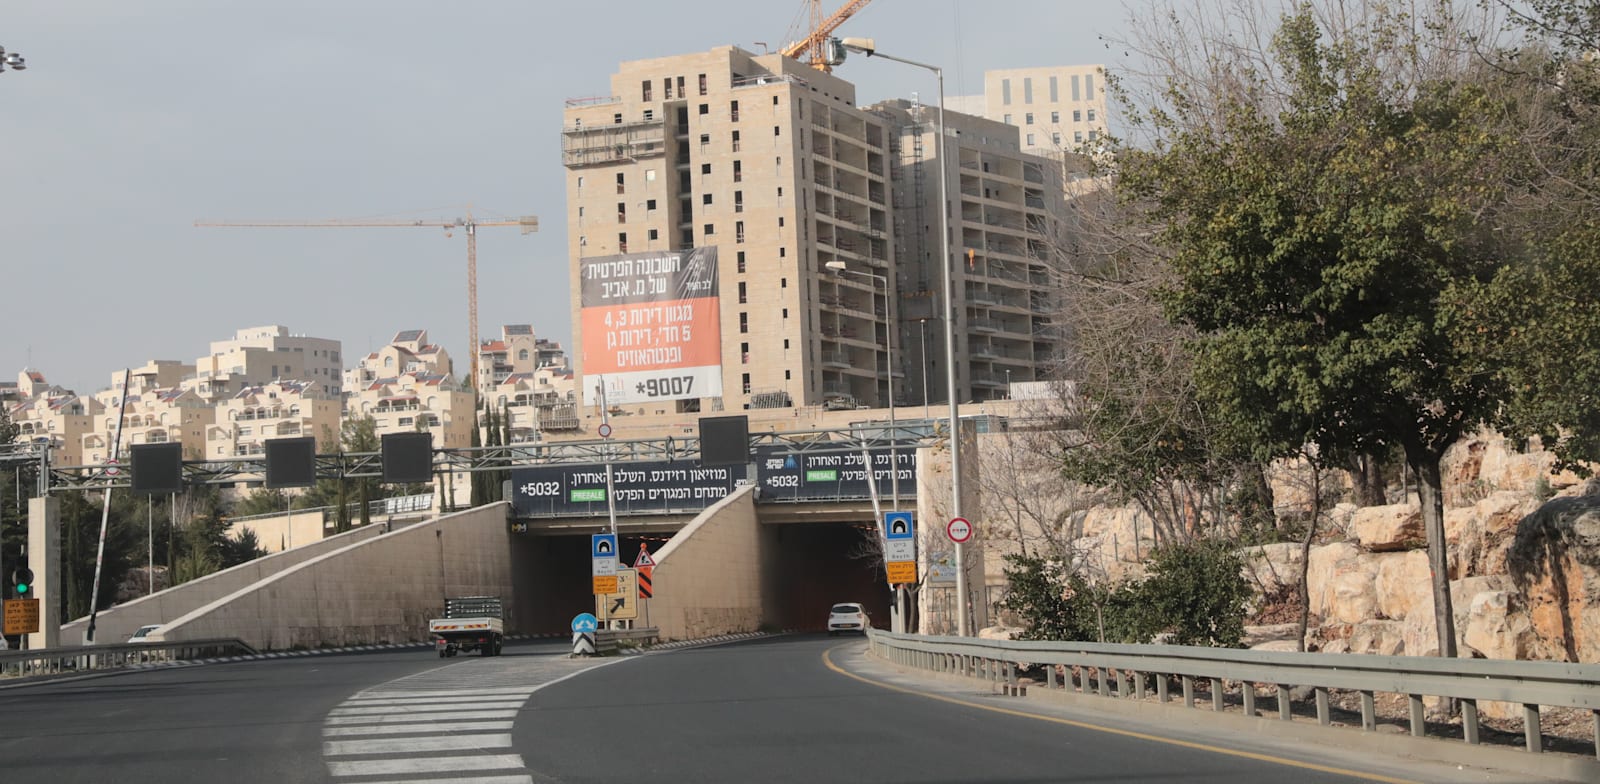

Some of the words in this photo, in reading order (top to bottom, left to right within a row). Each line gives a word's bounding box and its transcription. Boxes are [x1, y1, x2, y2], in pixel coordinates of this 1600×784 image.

[588, 261, 632, 279] הפרטית
[637, 256, 680, 275] השכונה
[602, 281, 629, 298] אביב
[633, 280, 645, 295] מ.
[648, 276, 666, 294] של
[702, 280, 711, 289] לב
[604, 312, 612, 327] 4
[616, 310, 626, 329] 3,
[630, 307, 662, 326] דירות
[666, 304, 693, 325] מגוון
[607, 331, 617, 350] גן
[620, 328, 651, 346] דירות
[682, 325, 691, 342] 5
[617, 346, 682, 367] ופנטהאוזים
[806, 455, 841, 468] האחרון.
[614, 468, 645, 483] השלב
[649, 470, 686, 482] רזידנס.
[690, 468, 727, 483] מוזיאון
[573, 491, 603, 499] PRESALE
[648, 487, 690, 500] המגורים
[694, 487, 727, 498] מתחם
